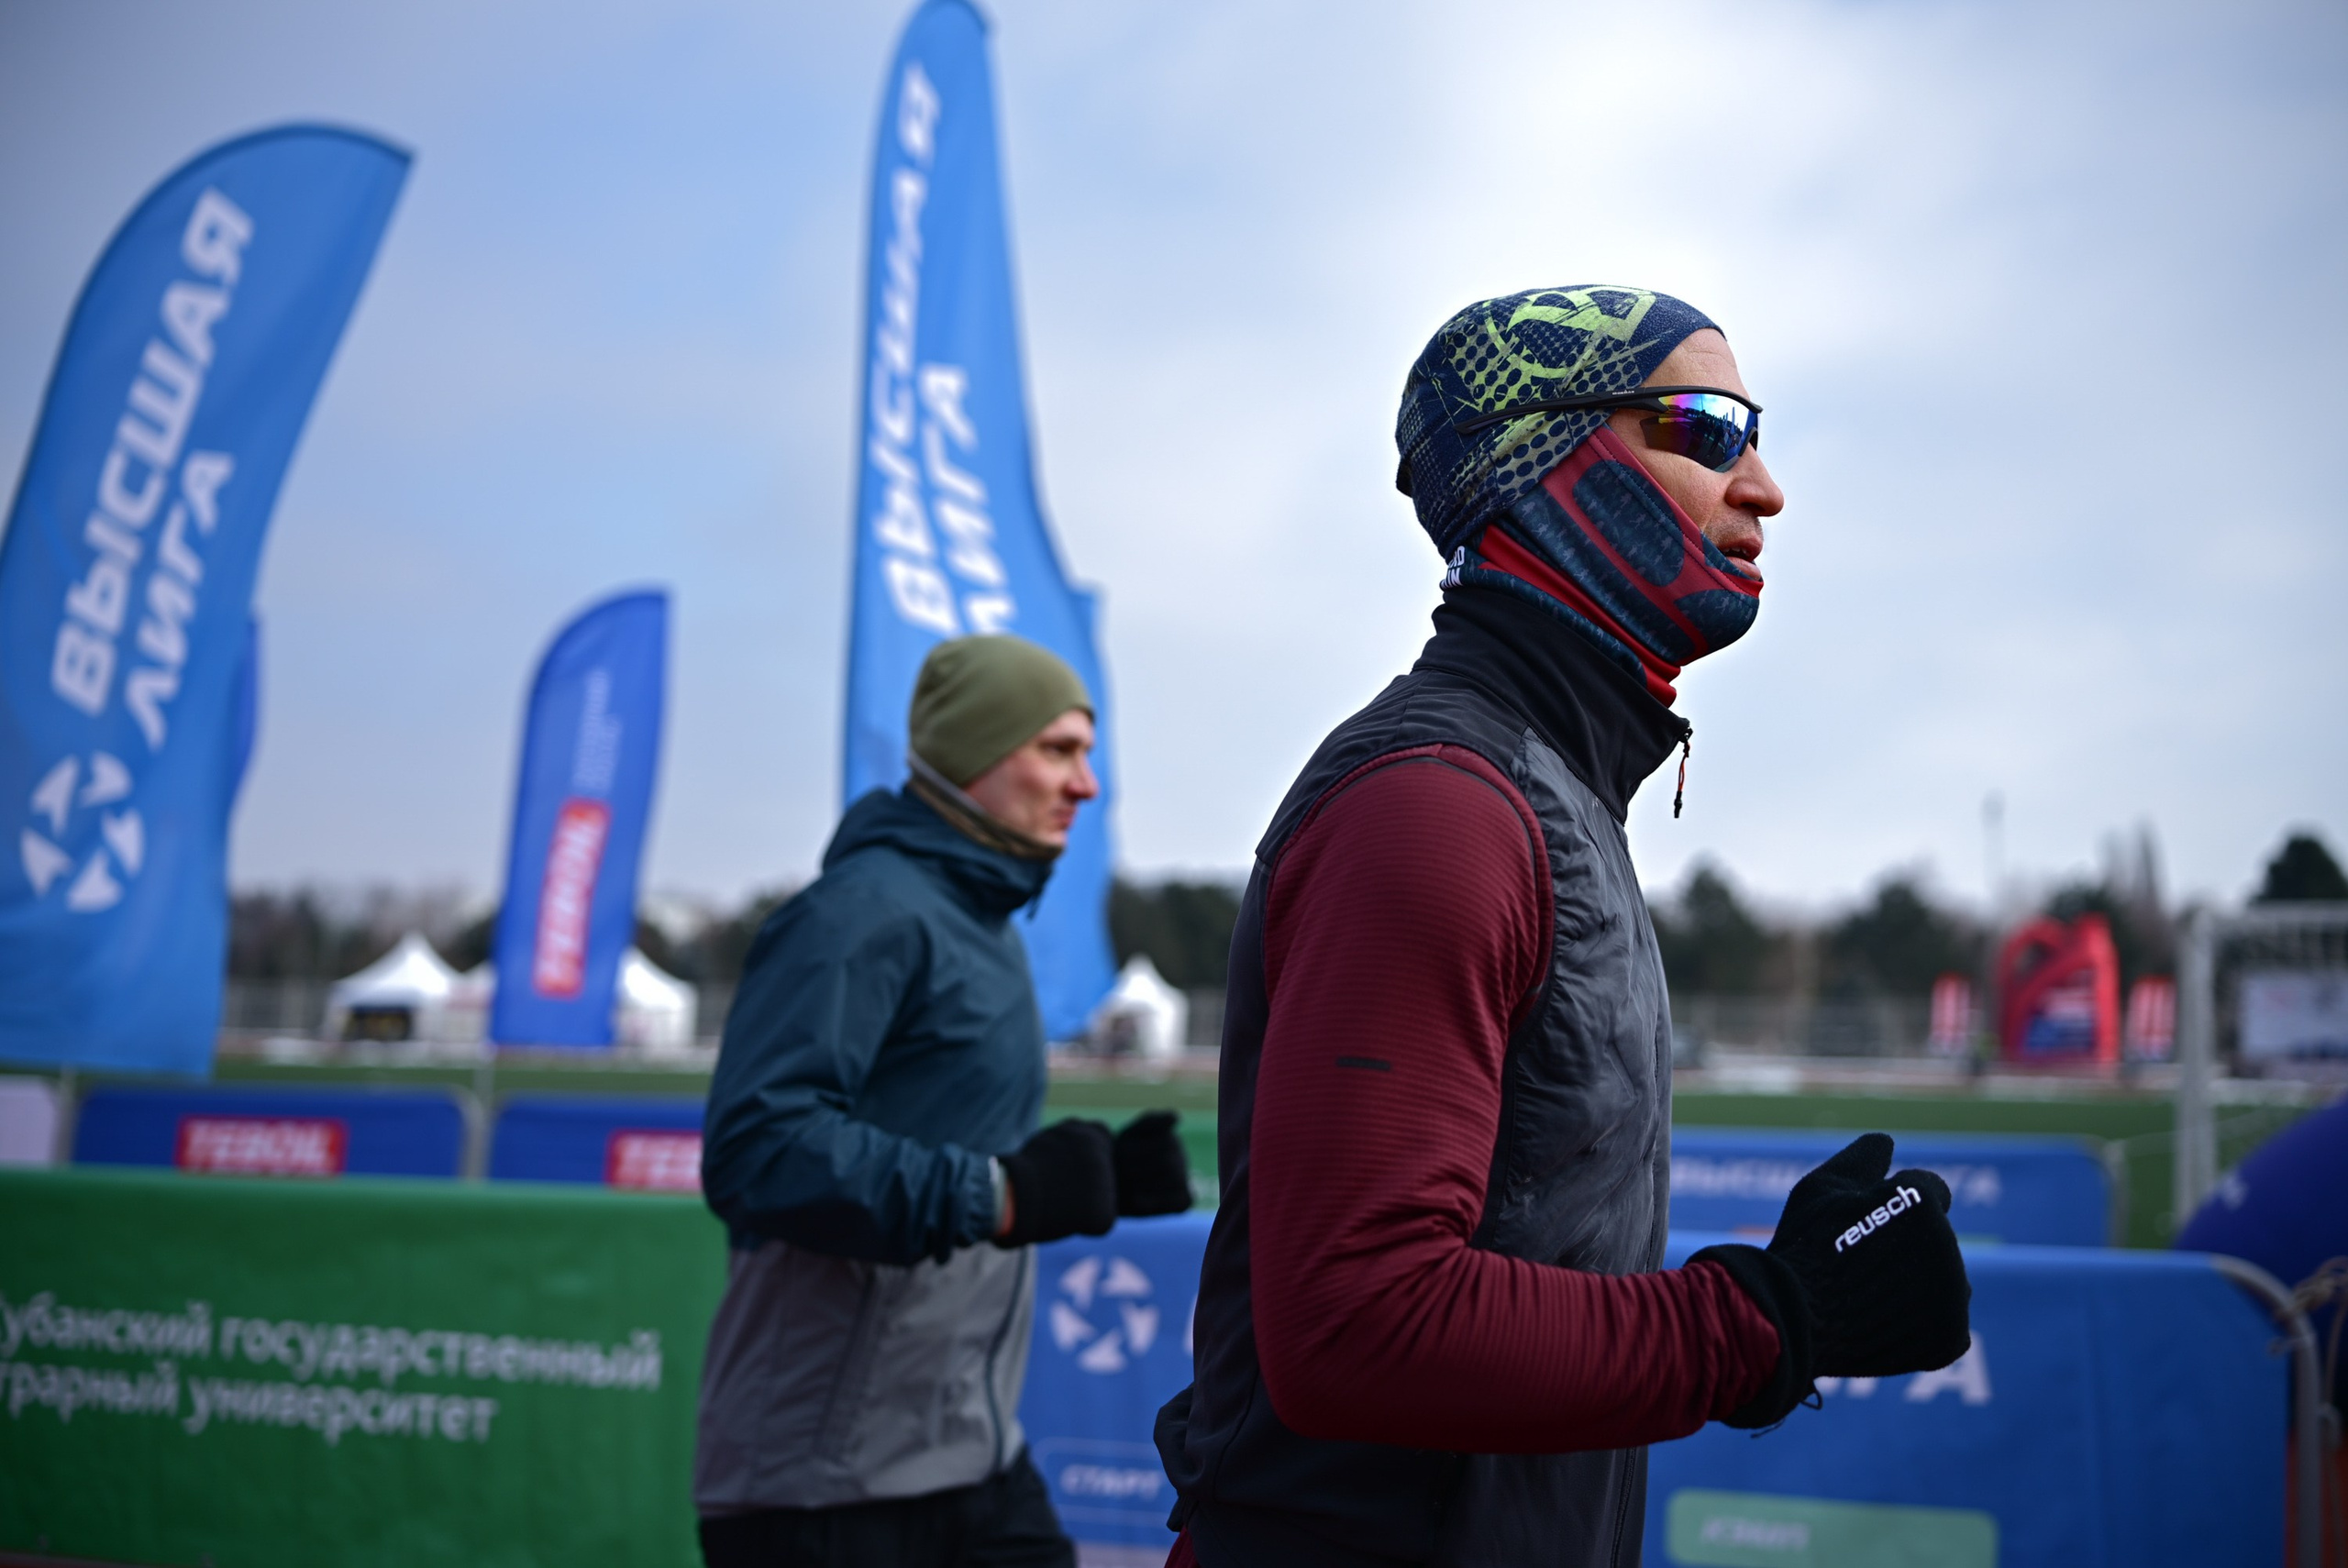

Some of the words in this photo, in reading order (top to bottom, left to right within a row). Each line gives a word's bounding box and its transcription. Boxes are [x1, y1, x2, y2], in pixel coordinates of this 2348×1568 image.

[51, 186, 255, 717] ВЫСШАЯ
[125, 447, 235, 752] ЛИГА
[1834, 1185, 1922, 1253] reusch
[220, 1315, 664, 1392] государственный
[183, 1375, 499, 1447] университет
